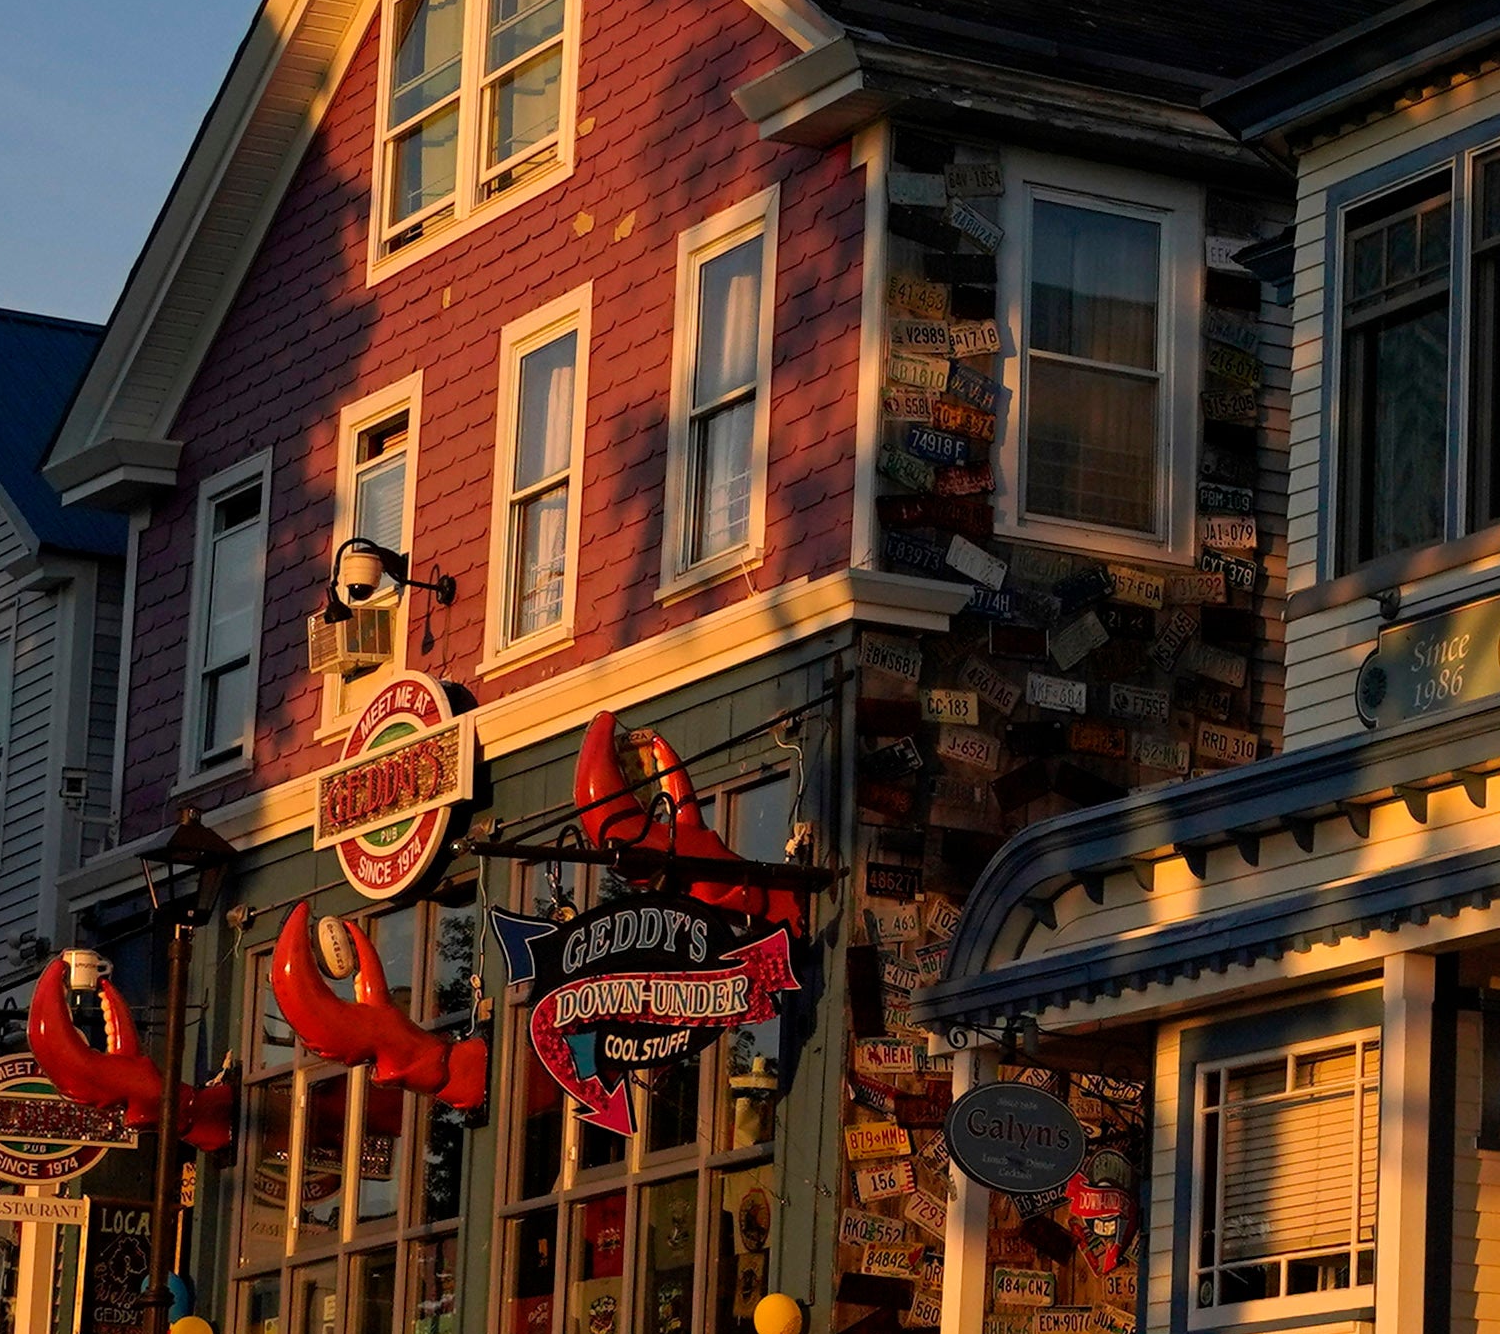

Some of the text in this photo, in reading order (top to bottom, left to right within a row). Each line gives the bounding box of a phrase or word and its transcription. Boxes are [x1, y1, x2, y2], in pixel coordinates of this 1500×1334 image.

[1228, 562, 1253, 586] 378
[1409, 630, 1472, 673] Since
[1412, 665, 1465, 710] 1986
[360, 686, 430, 740] MEET ME AT
[1202, 730, 1254, 758] RRD 310
[326, 741, 442, 827] GEDDY'S
[380, 826, 398, 844] PUB
[357, 836, 422, 885] SINCE 1974
[561, 907, 710, 974] GEDDY'S
[552, 973, 749, 1028] DOWN-UNDER
[604, 1028, 692, 1062] COOL STUFF!
[849, 1126, 907, 1151] 879 MMB
[966, 1107, 1071, 1152] Galyn's
[23, 1143, 48, 1154] PUB
[48, 1156, 79, 1176] 1974
[871, 1171, 896, 1192] 156
[100, 1207, 151, 1237] LOCA
